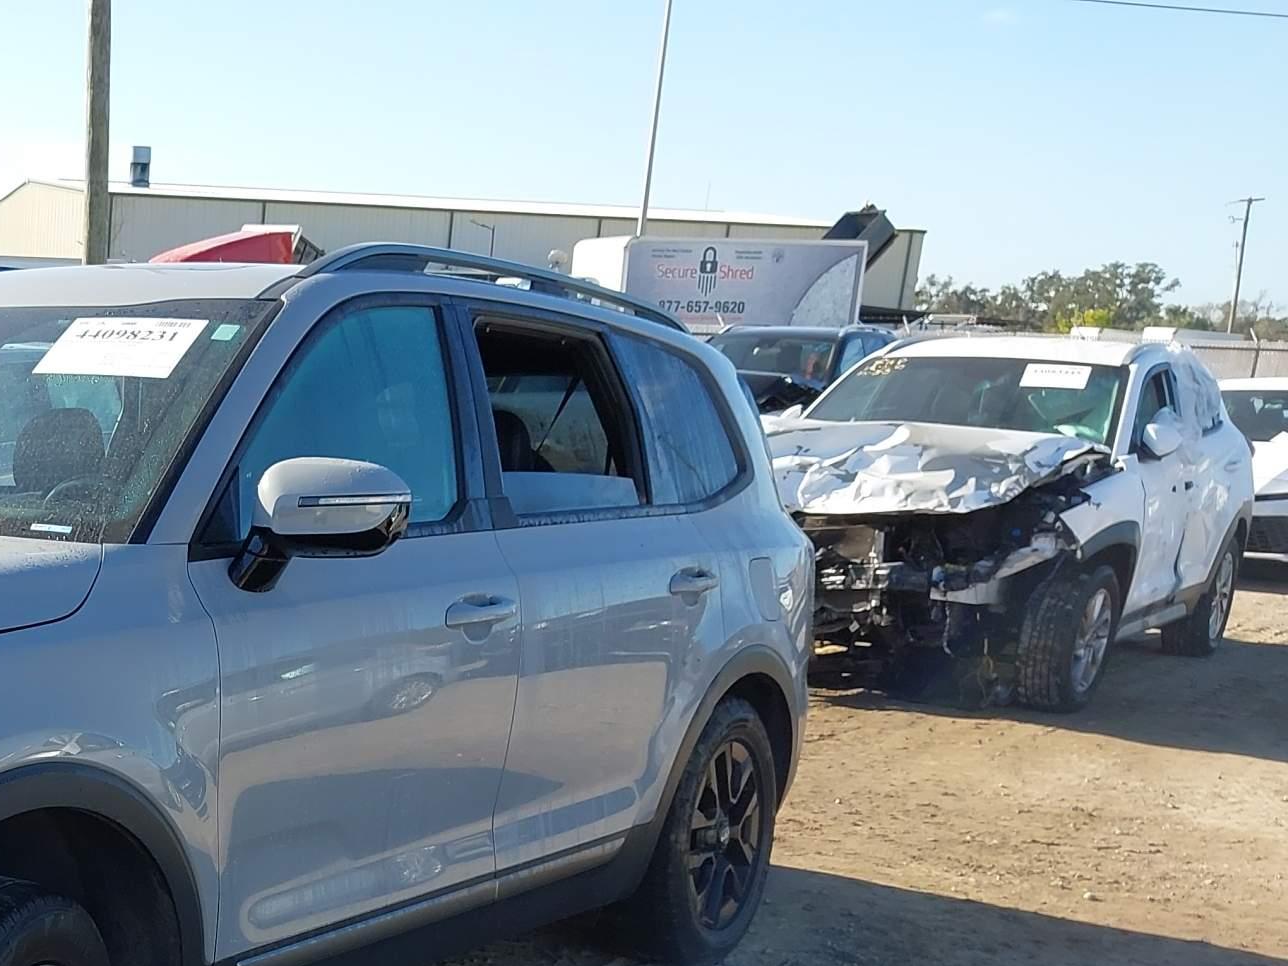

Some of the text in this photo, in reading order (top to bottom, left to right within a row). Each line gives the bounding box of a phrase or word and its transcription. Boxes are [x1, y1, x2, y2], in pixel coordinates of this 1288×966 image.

[656, 263, 754, 280] Secure Shred
[75, 328, 179, 342] 44098231
